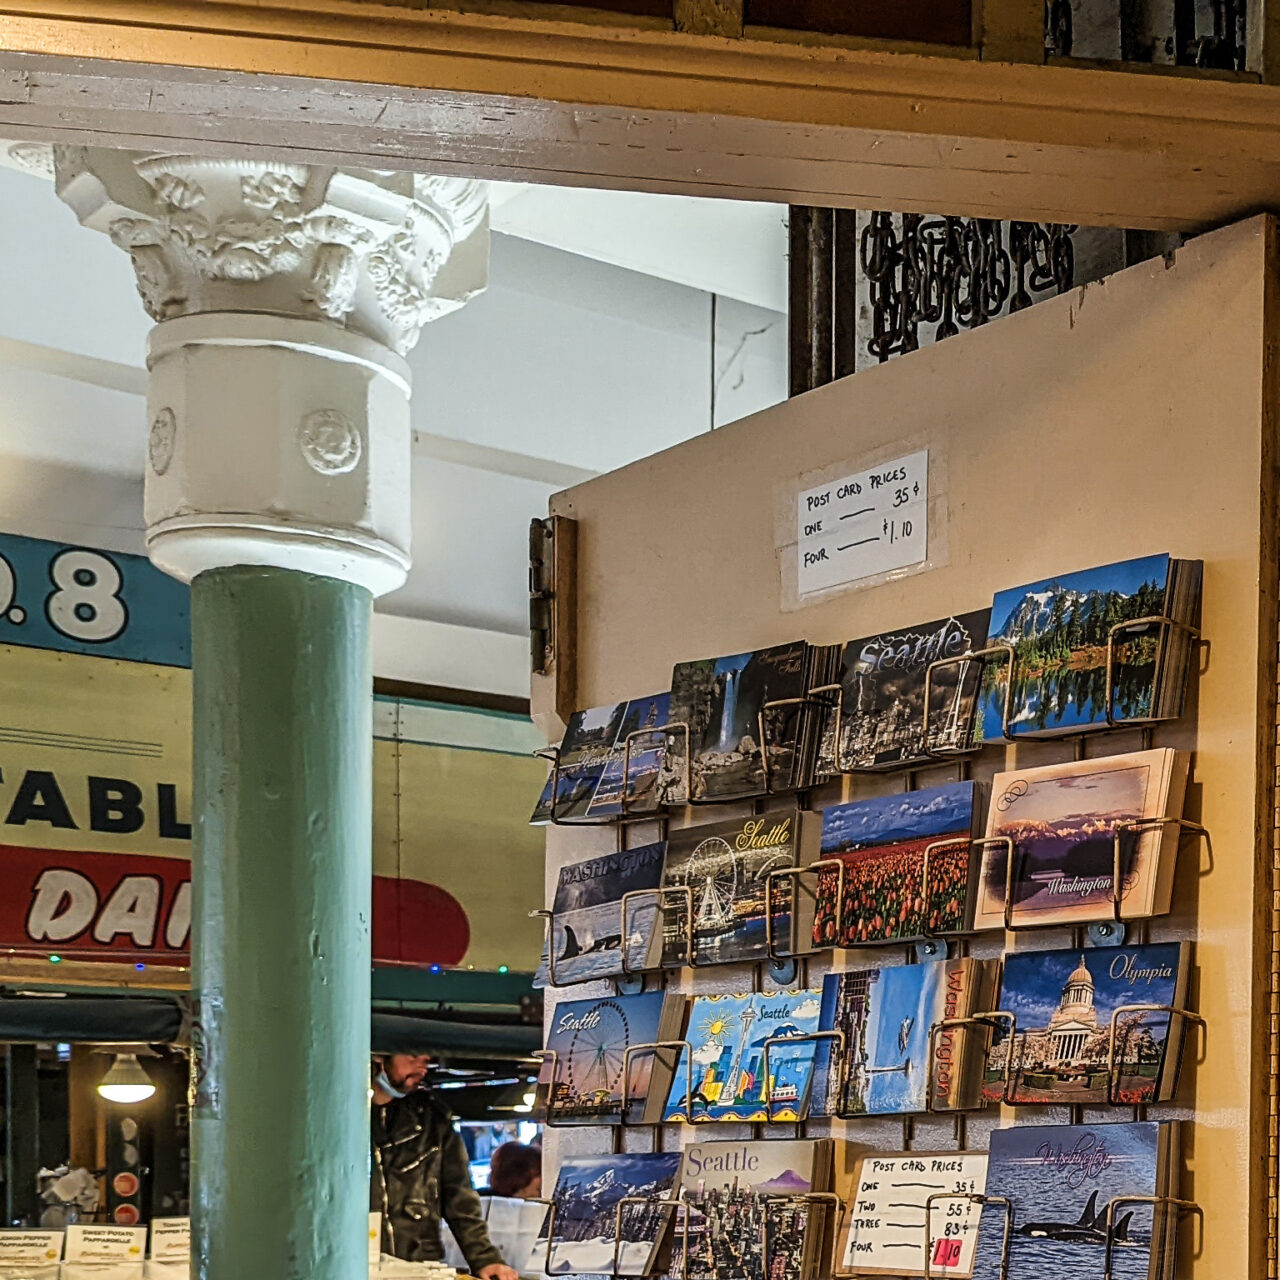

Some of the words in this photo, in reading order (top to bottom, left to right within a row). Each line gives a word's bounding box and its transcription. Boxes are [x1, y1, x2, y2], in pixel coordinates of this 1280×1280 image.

[807, 491, 831, 511] POST
[837, 482, 862, 499] CARD
[869, 467, 907, 489] PRICES
[804, 521, 823, 536] ONE
[804, 548, 829, 568] FOUR
[0, 547, 129, 643] .8
[860, 622, 963, 676] Seattle
[0, 770, 192, 841] ABL
[736, 818, 790, 850] Seattle
[1047, 876, 1111, 898] Washington
[1109, 953, 1173, 985] Olympia
[556, 1011, 601, 1034] Seattle
[758, 1003, 791, 1022] Seattle
[936, 969, 965, 1097] Wasington
[687, 1147, 759, 1177] Seattle
[872, 1160, 895, 1172] POST
[901, 1161, 926, 1172] CARD
[931, 1160, 963, 1172] PRICES
[861, 1181, 880, 1192] ONE
[858, 1201, 876, 1213] TWO
[854, 1219, 881, 1229] THREE
[850, 1241, 873, 1254] FOUR
